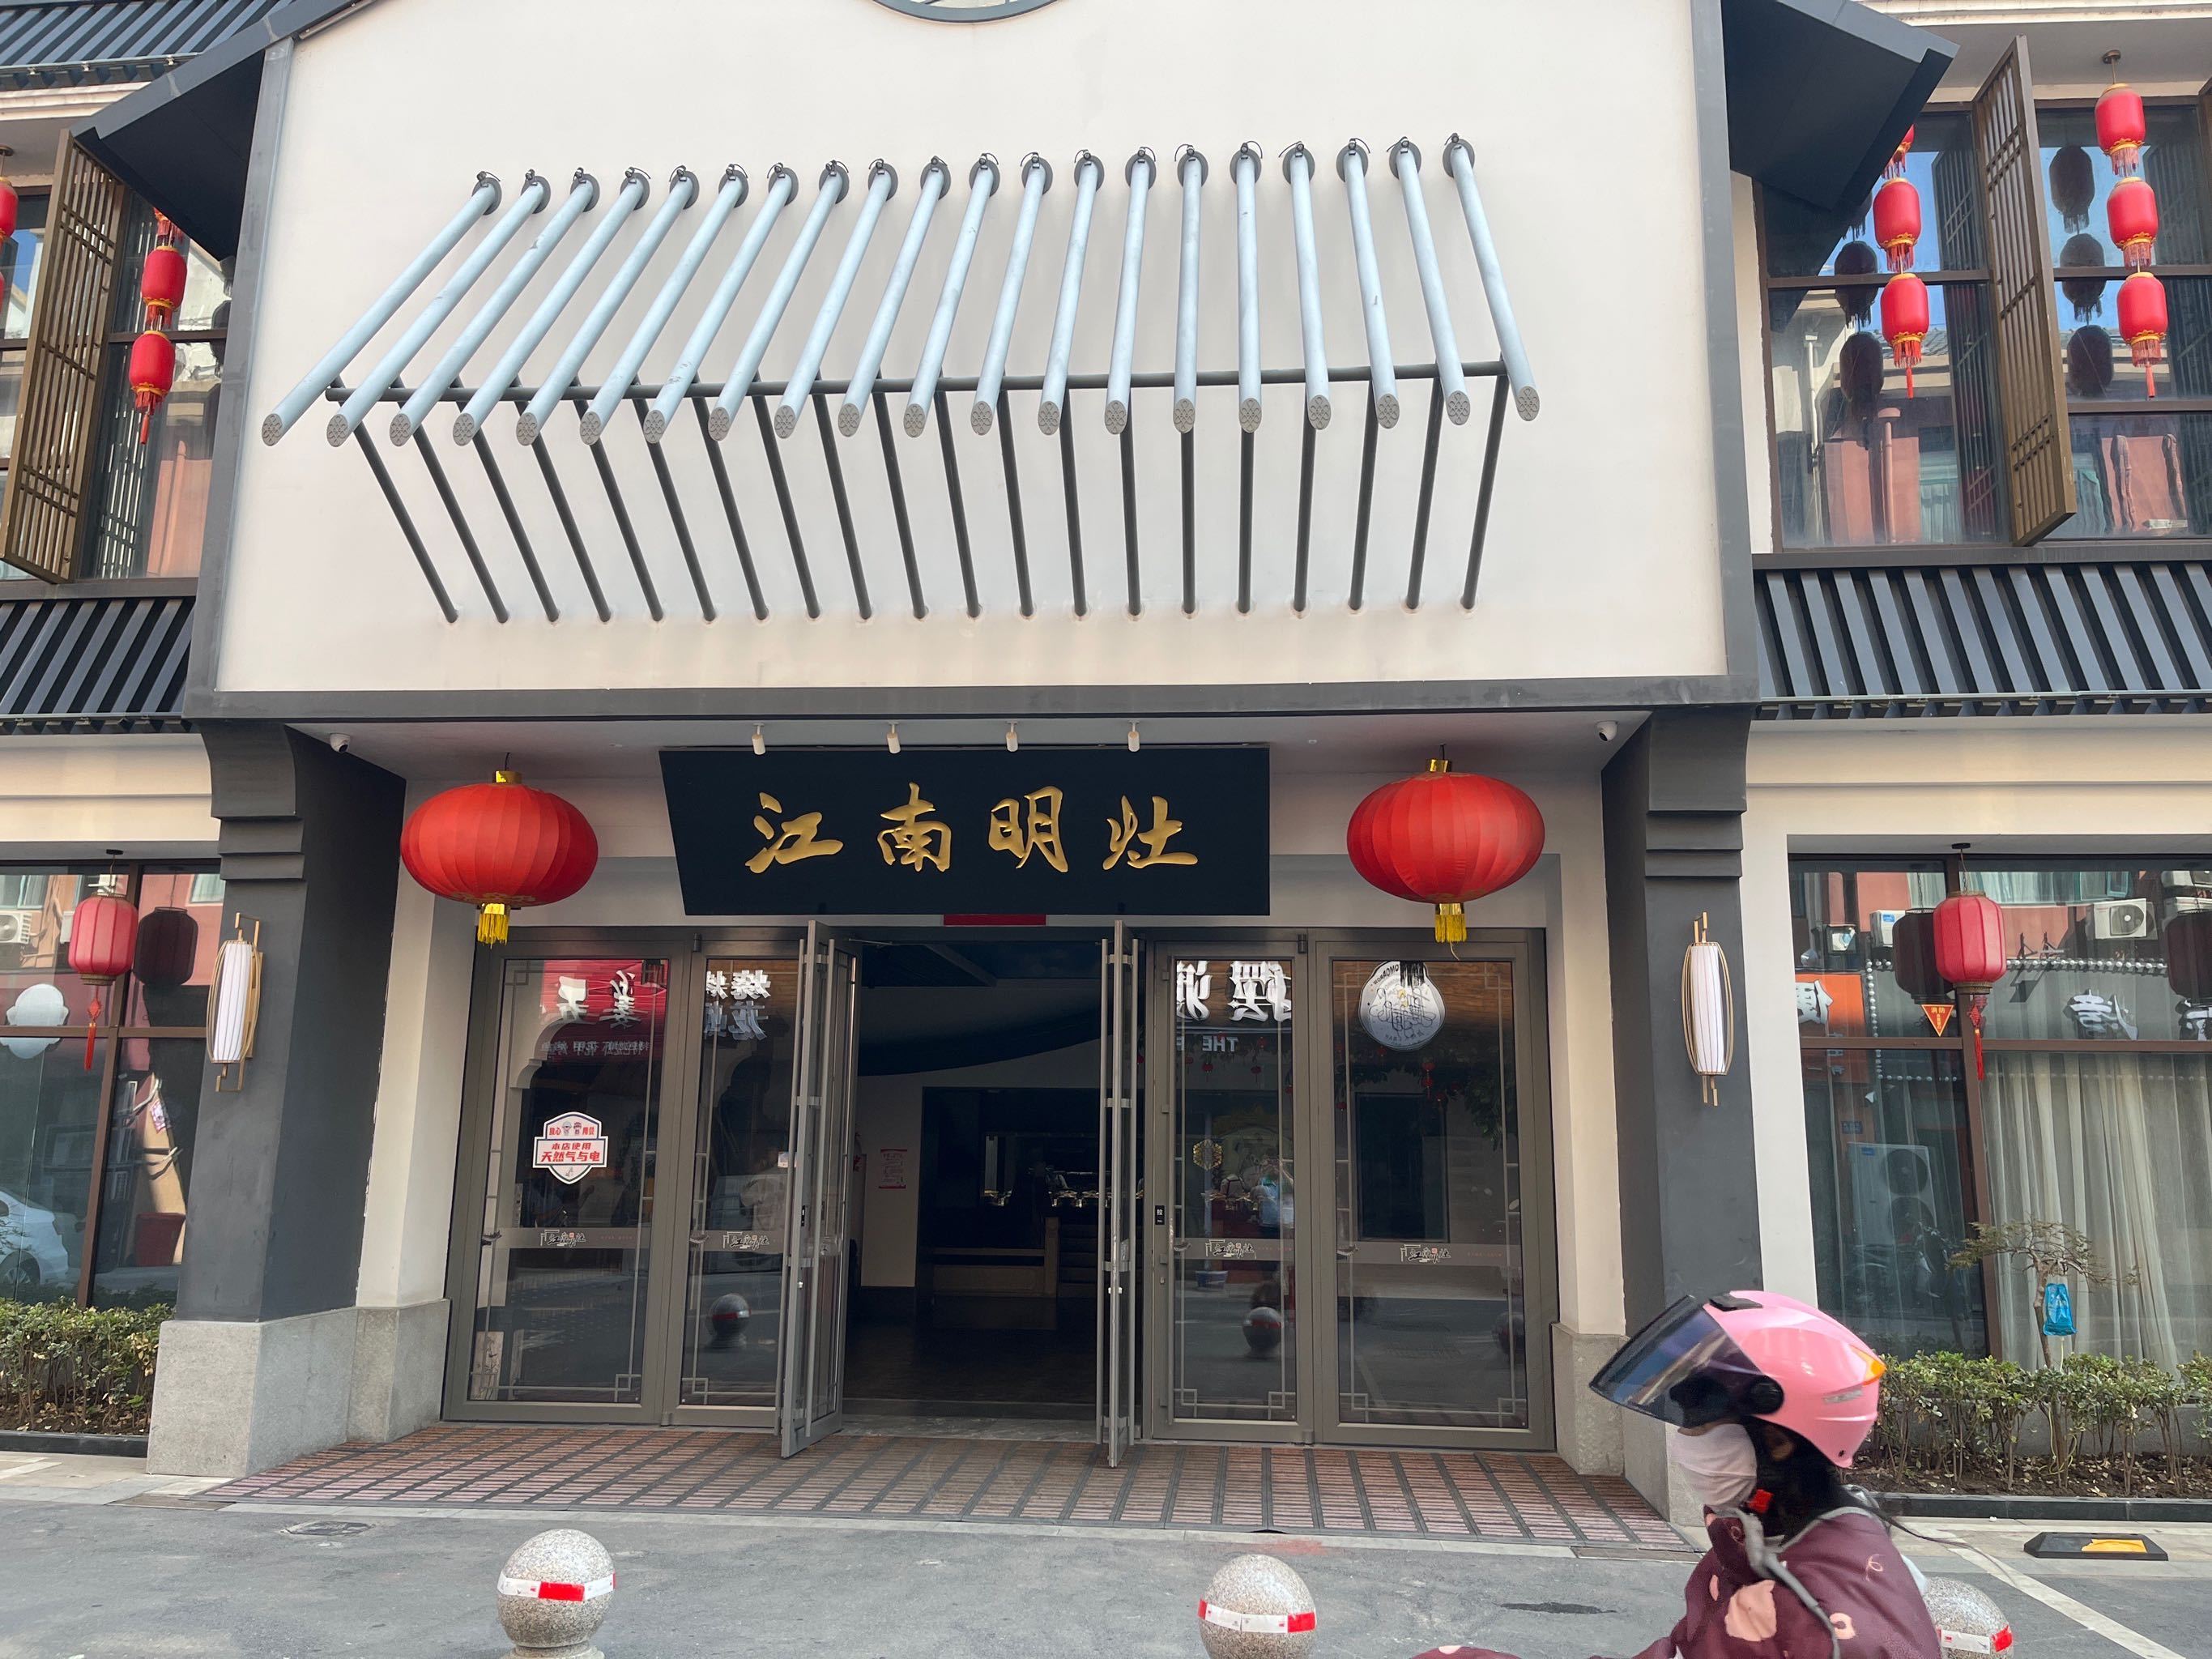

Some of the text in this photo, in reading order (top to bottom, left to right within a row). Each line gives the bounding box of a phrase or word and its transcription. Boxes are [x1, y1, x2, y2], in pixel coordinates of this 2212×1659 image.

[744, 782, 1199, 873] 江南明灶
[552, 1142, 591, 1150] 本店使用
[540, 1150, 601, 1162] 天然气与电
